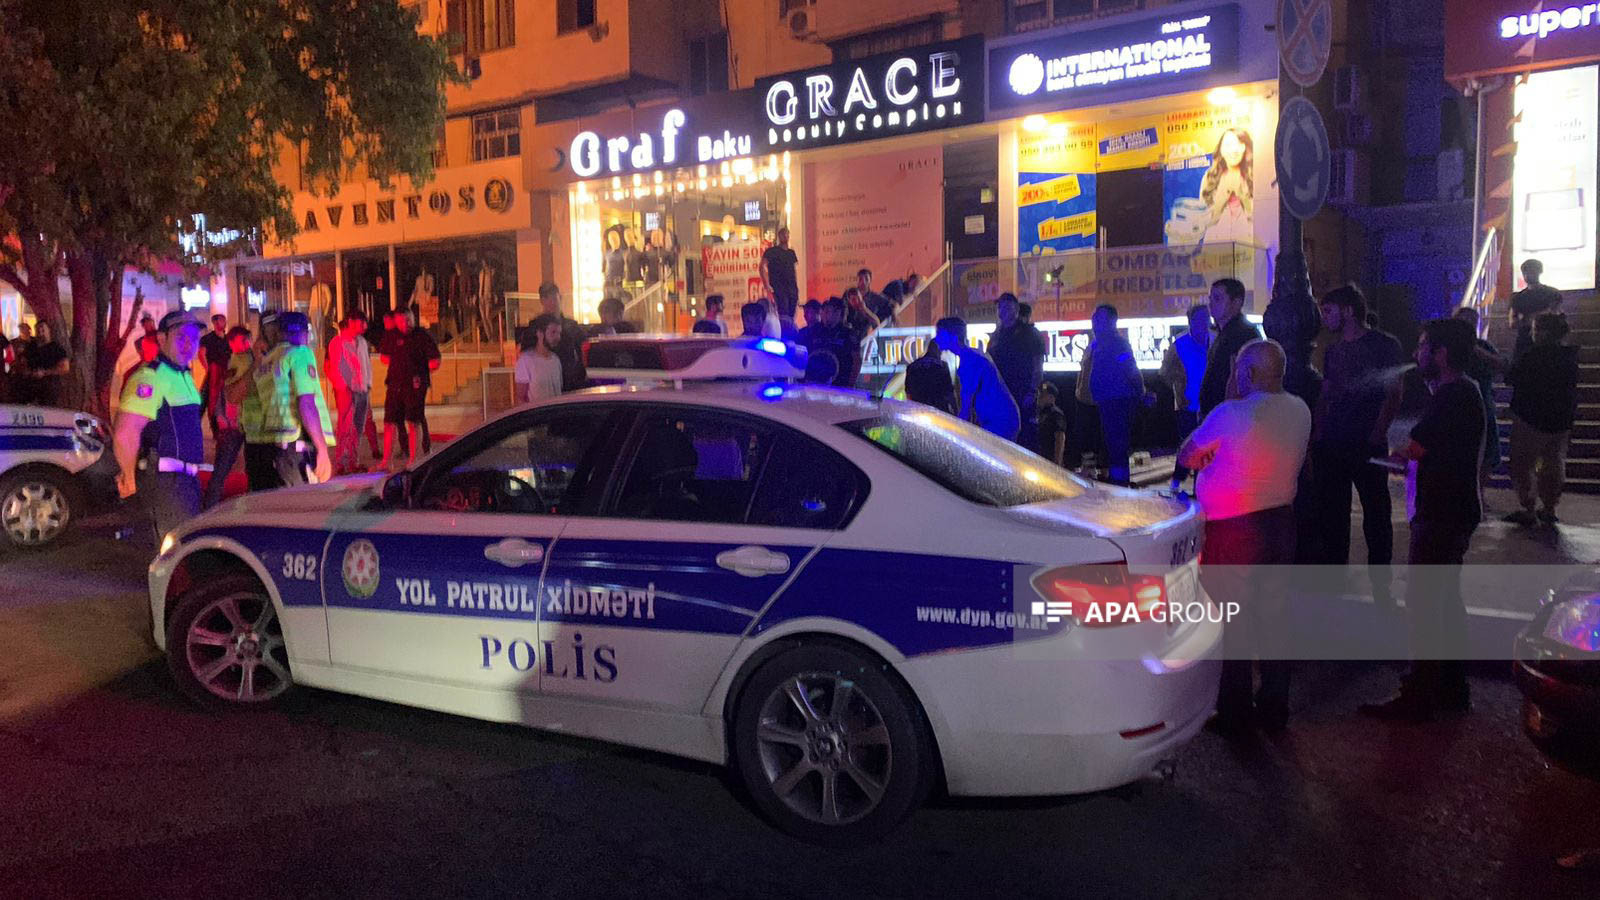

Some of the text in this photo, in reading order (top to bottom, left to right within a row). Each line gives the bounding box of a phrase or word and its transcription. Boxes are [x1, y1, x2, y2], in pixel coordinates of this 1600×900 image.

[1501, 2, 1600, 38] super
[1047, 34, 1211, 81] INTERNATIONAL
[766, 51, 960, 125] GRACE
[570, 109, 751, 177] Graf Baku
[282, 552, 316, 581] 362
[396, 577, 655, 620] YOL PATRUL XİDMƏTİ
[479, 632, 619, 683] POLİS
